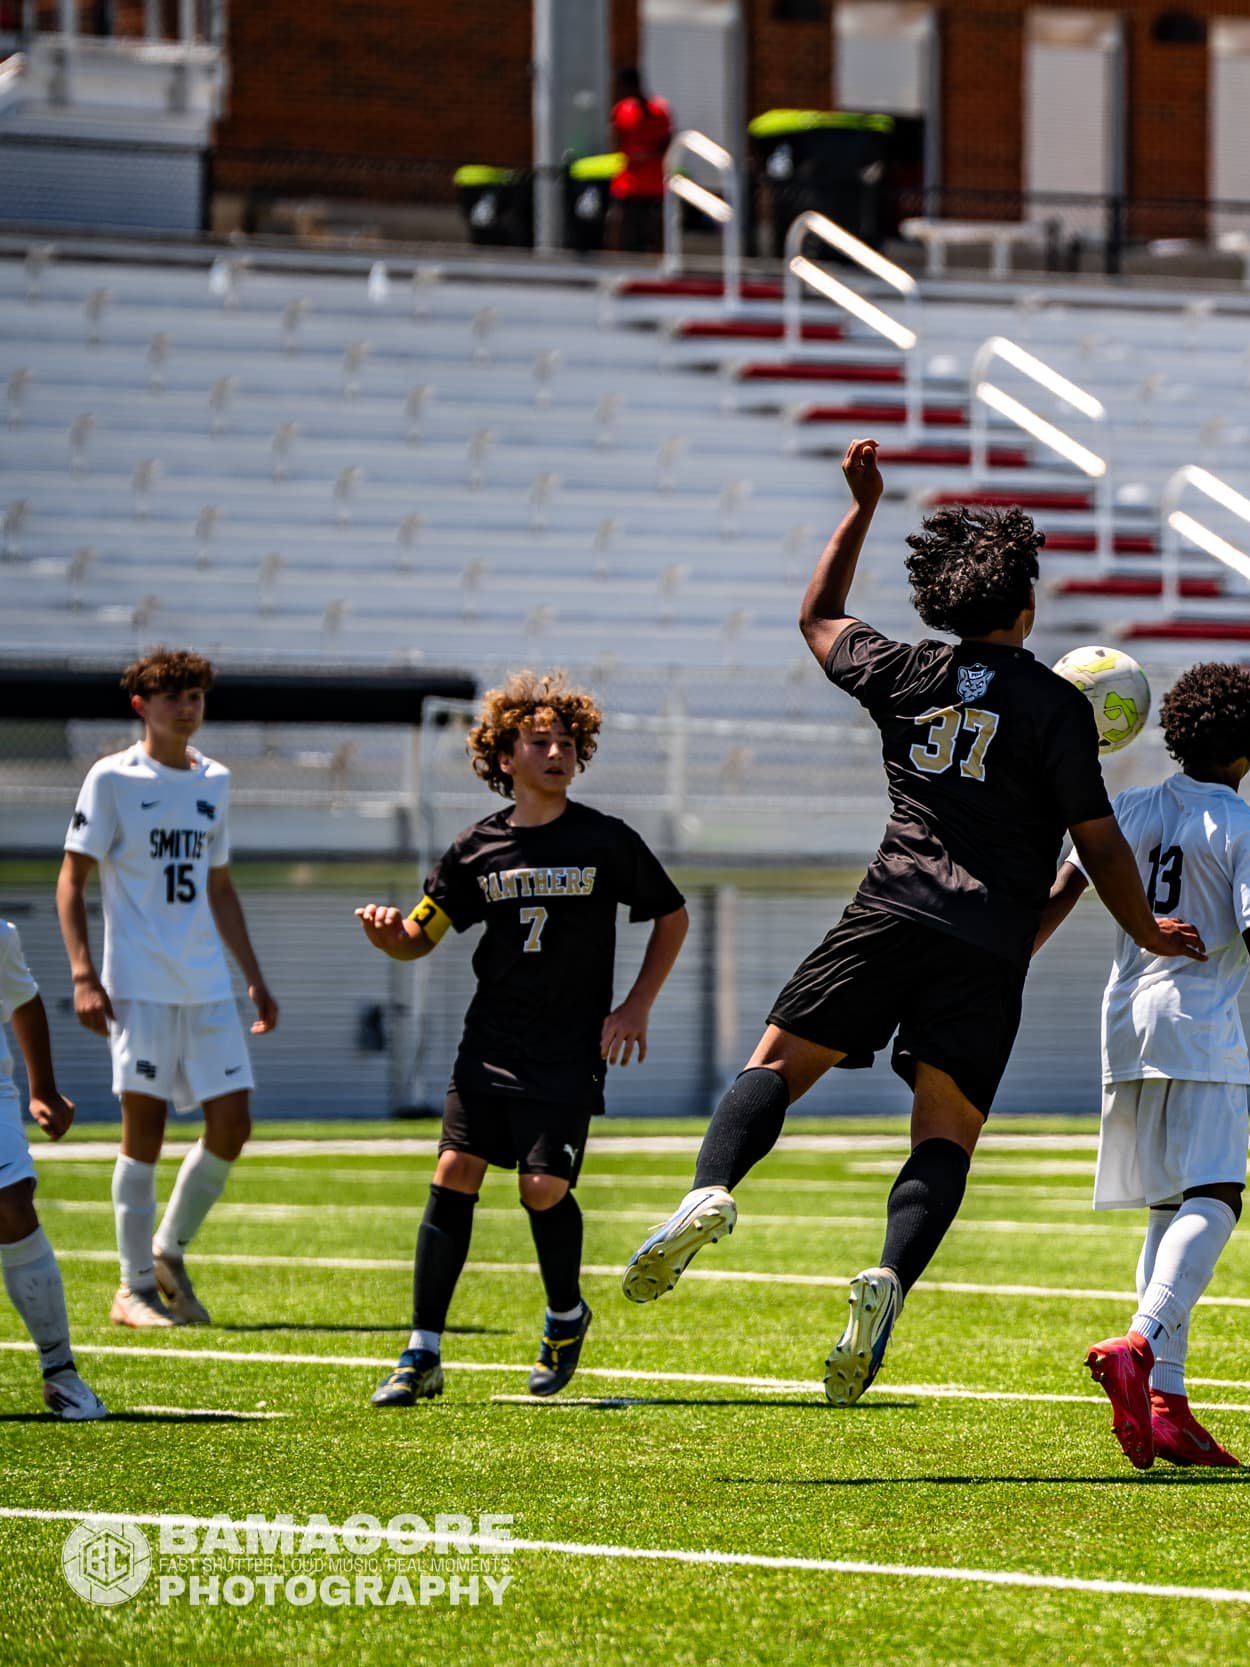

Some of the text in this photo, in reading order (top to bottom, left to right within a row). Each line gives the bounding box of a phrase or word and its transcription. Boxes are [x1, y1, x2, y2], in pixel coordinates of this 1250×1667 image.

[909, 706, 1000, 781] 37
[164, 863, 196, 904] 15
[477, 866, 597, 902] PANTHERS
[1147, 843, 1184, 914] 13
[519, 906, 549, 952] 7
